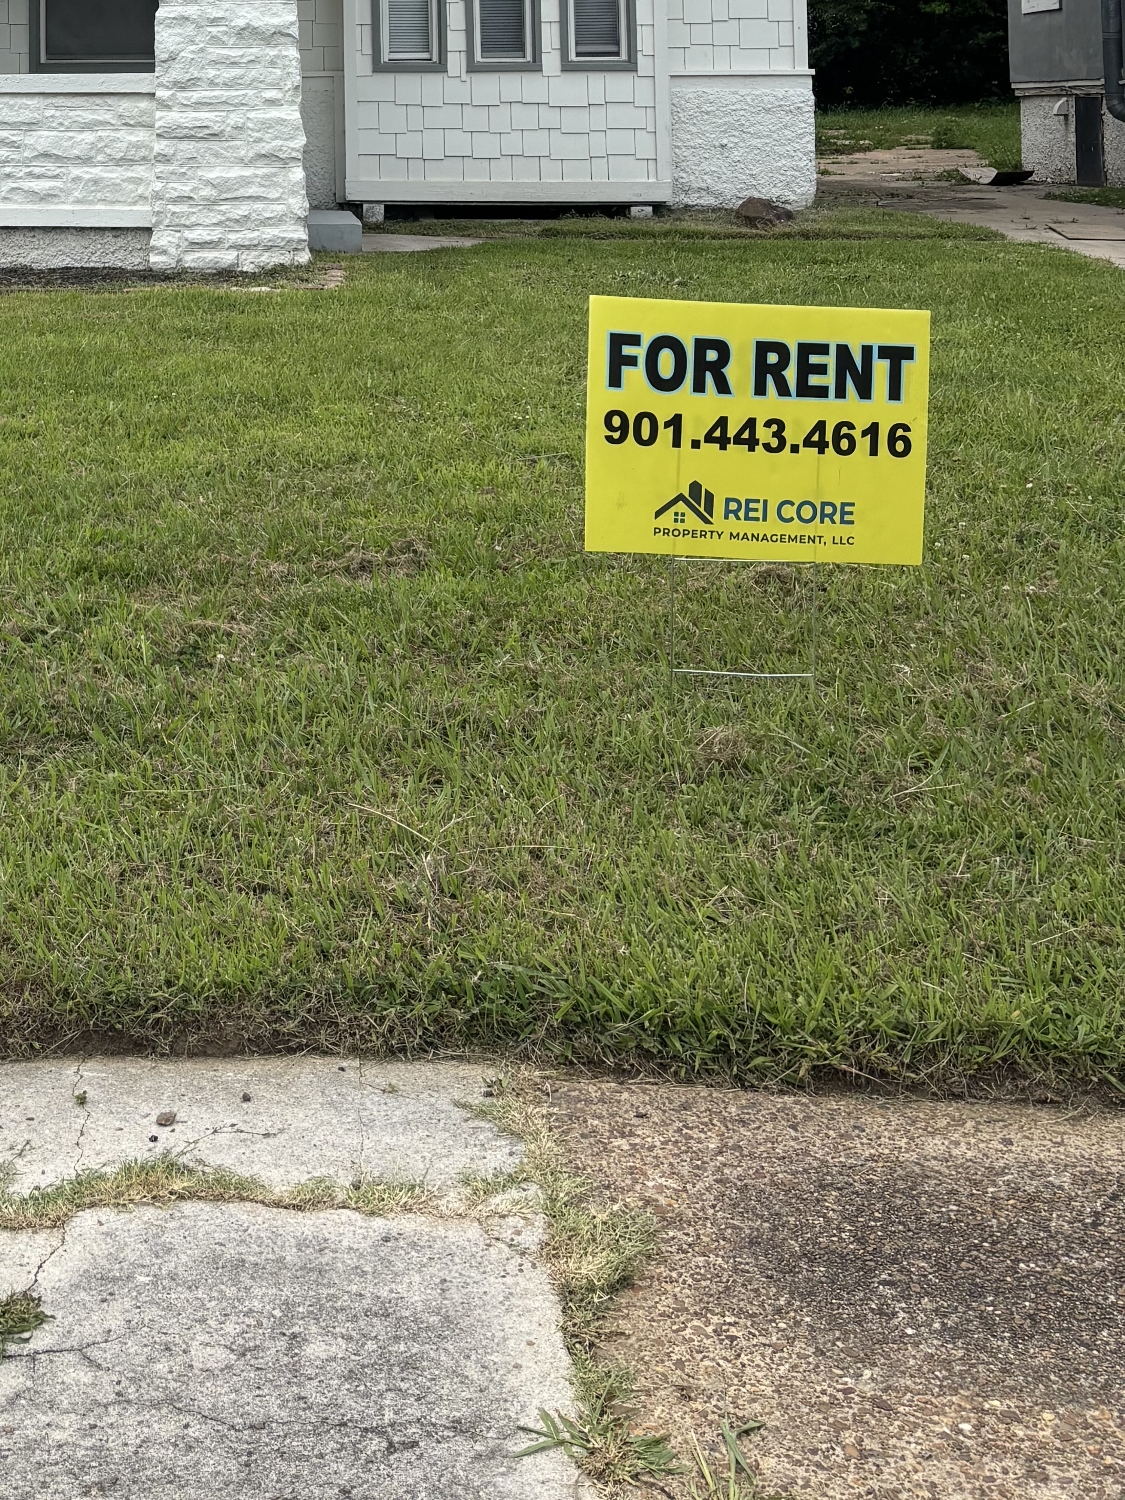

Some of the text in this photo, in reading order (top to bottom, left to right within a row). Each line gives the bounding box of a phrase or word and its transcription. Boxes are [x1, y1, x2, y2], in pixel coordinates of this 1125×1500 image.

[606, 330, 916, 403] FOR RENT
[603, 409, 912, 458] 901.443.4616
[723, 497, 856, 525] REI CORE
[653, 527, 855, 547] PROPERTY MANAGEMENT, LLC
